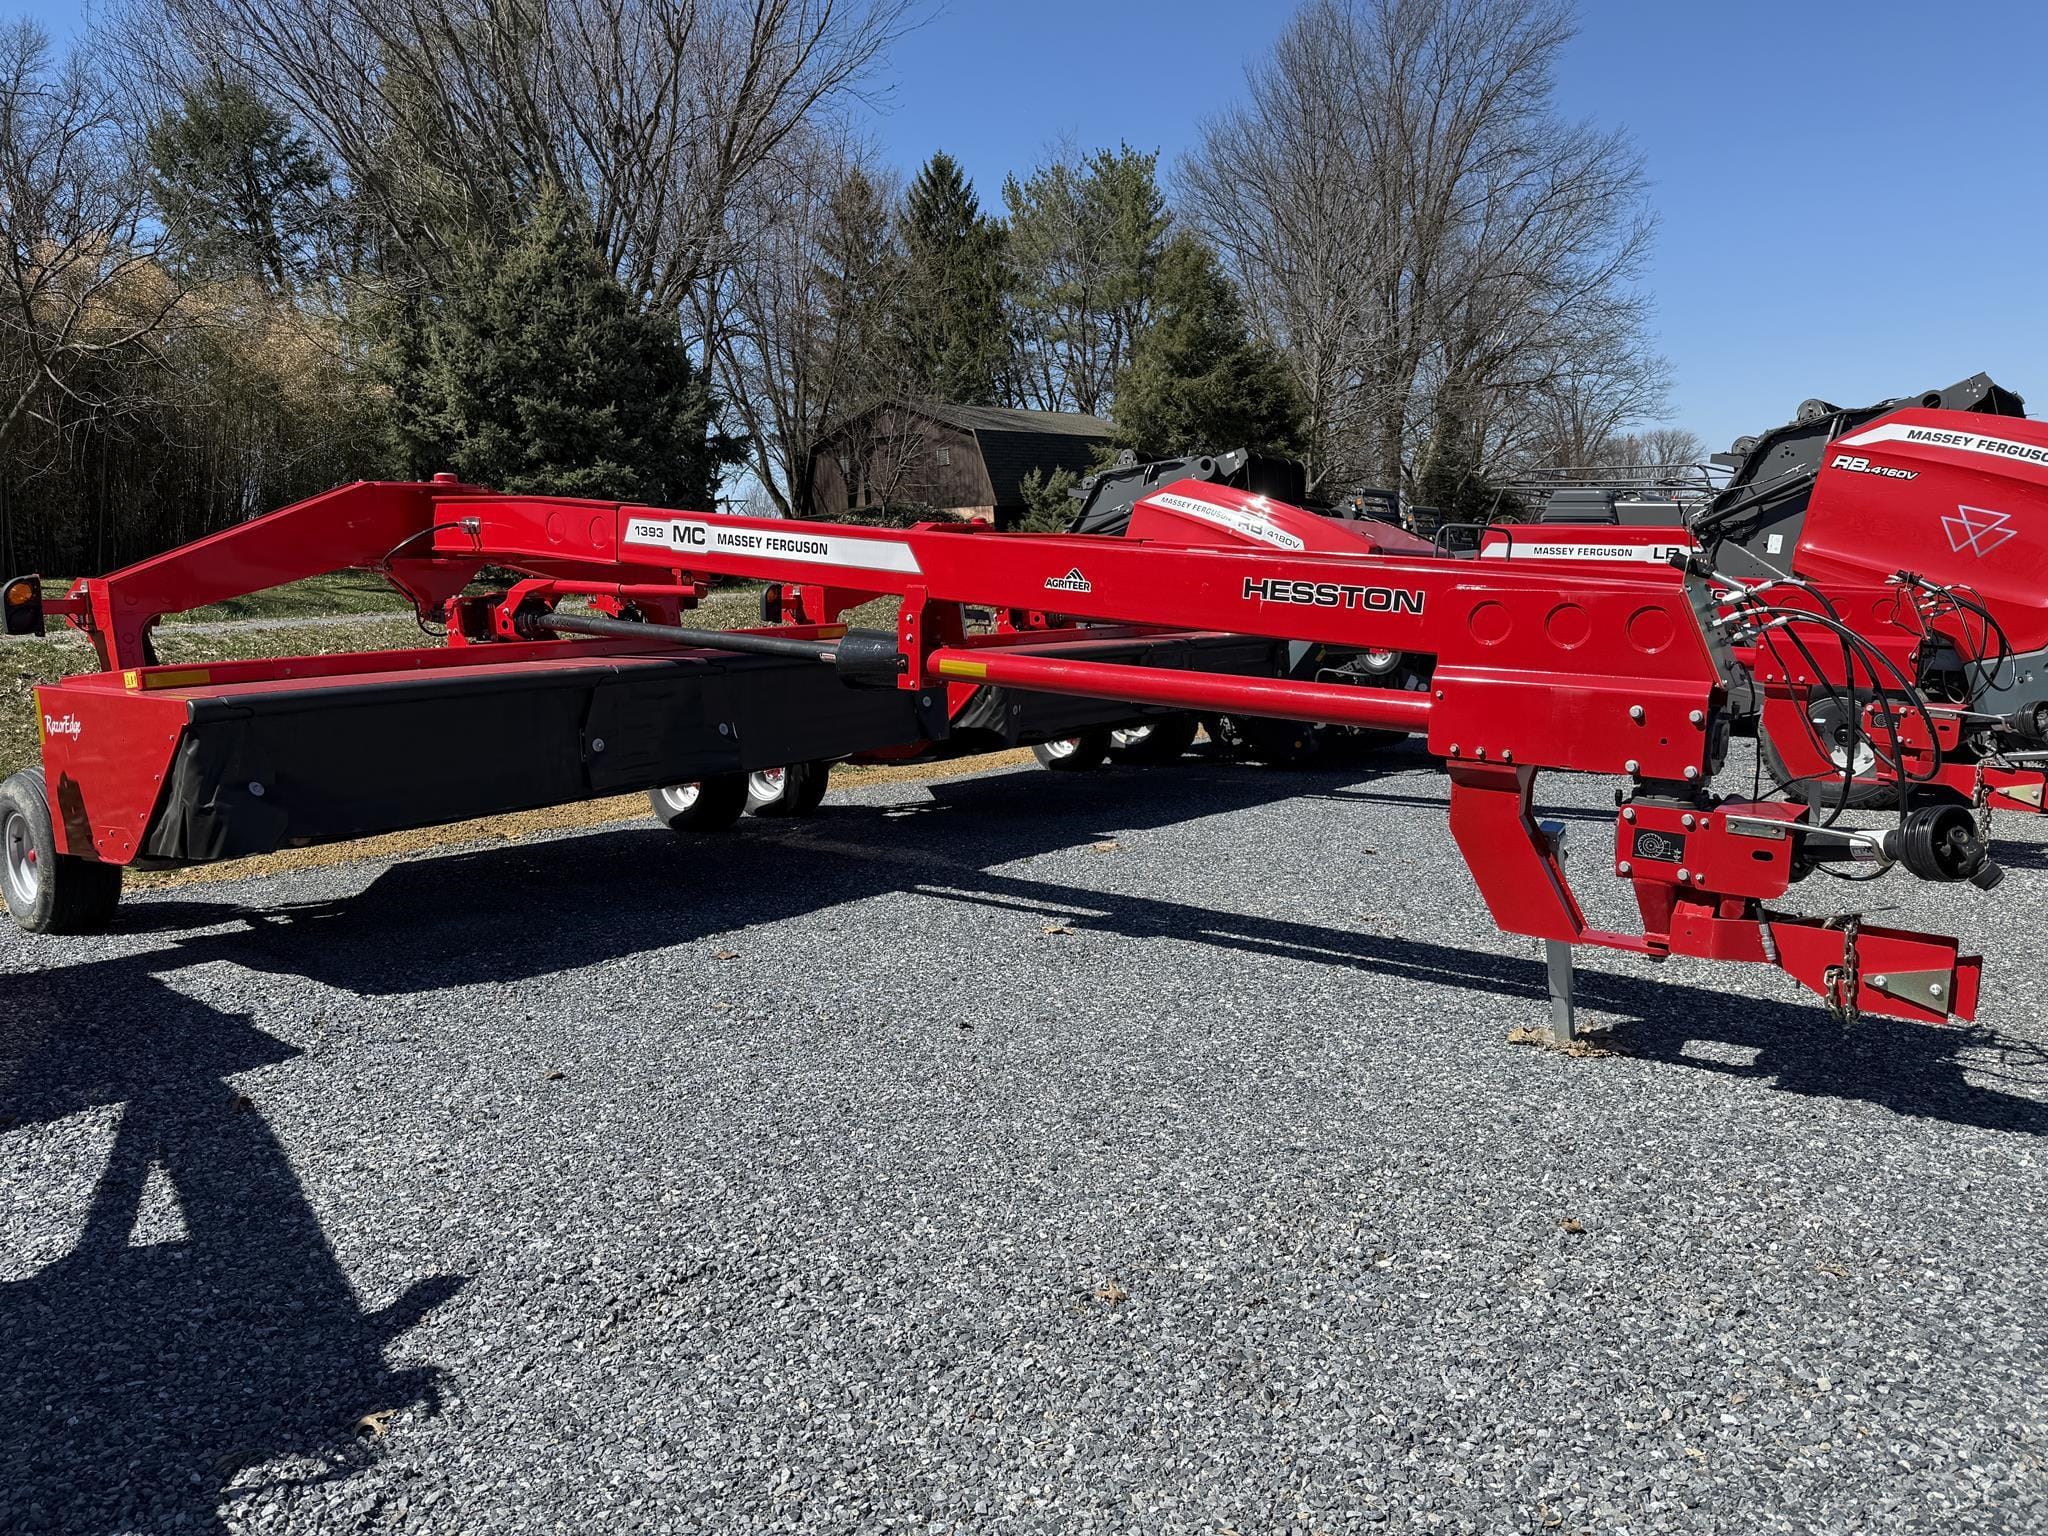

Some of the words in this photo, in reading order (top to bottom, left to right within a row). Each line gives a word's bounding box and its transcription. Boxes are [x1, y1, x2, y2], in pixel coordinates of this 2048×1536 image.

[1907, 430, 1974, 447] MASSEY
[1161, 496, 1191, 509] MASSEY
[1267, 530, 1301, 549] 4180V
[634, 525, 664, 538] 1393
[673, 525, 706, 545] MC
[717, 533, 762, 549] MASSEY
[766, 538, 828, 555] FERGUSON
[1533, 546, 1574, 556] MASSEY
[1577, 547, 1633, 557] FERGUSON
[1045, 578, 1090, 591] AGRITEER
[1243, 577, 1425, 615] HESSTON
[44, 713, 81, 741] RazorEdge
